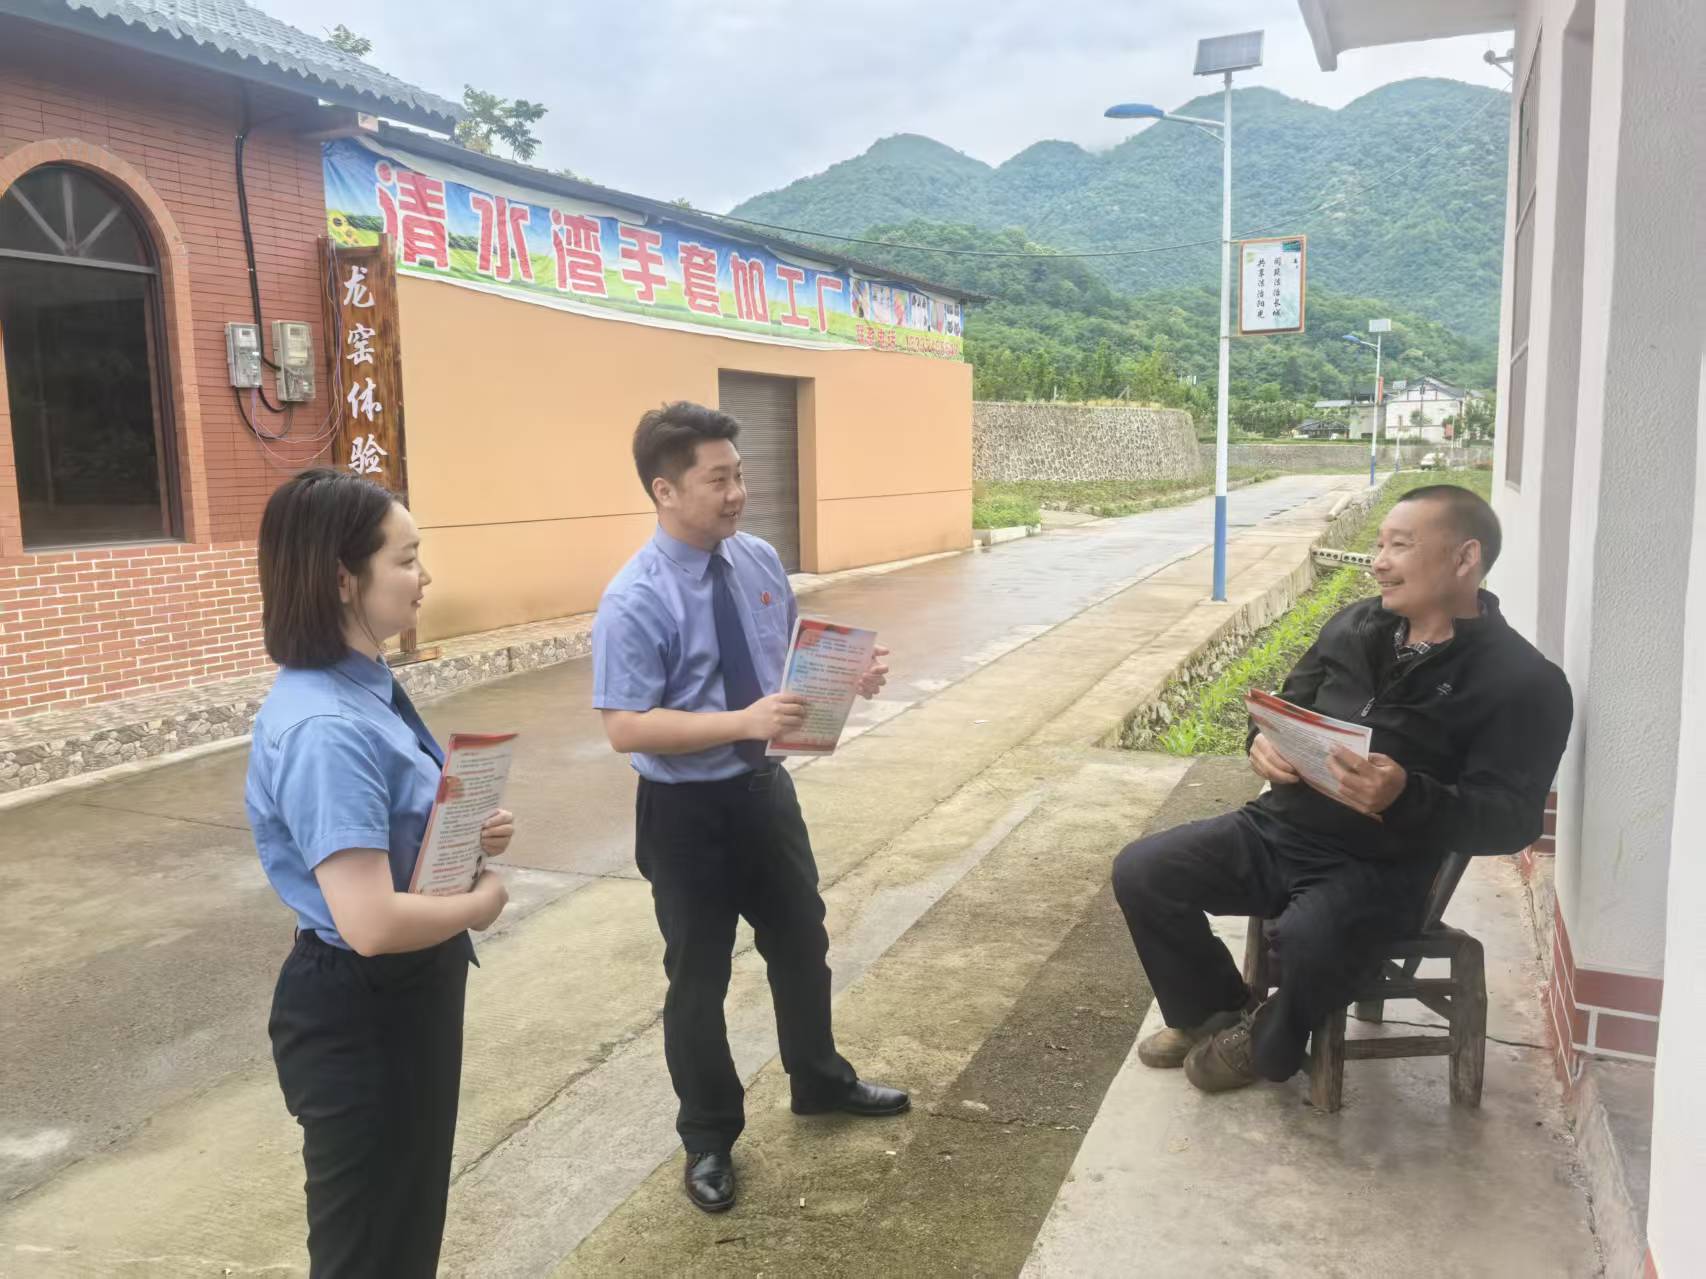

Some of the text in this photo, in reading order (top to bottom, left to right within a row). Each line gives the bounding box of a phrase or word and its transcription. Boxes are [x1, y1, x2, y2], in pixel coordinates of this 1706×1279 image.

[375, 160, 843, 333] 清水湾手套加工厂
[343, 265, 388, 475] 龙窑体验
